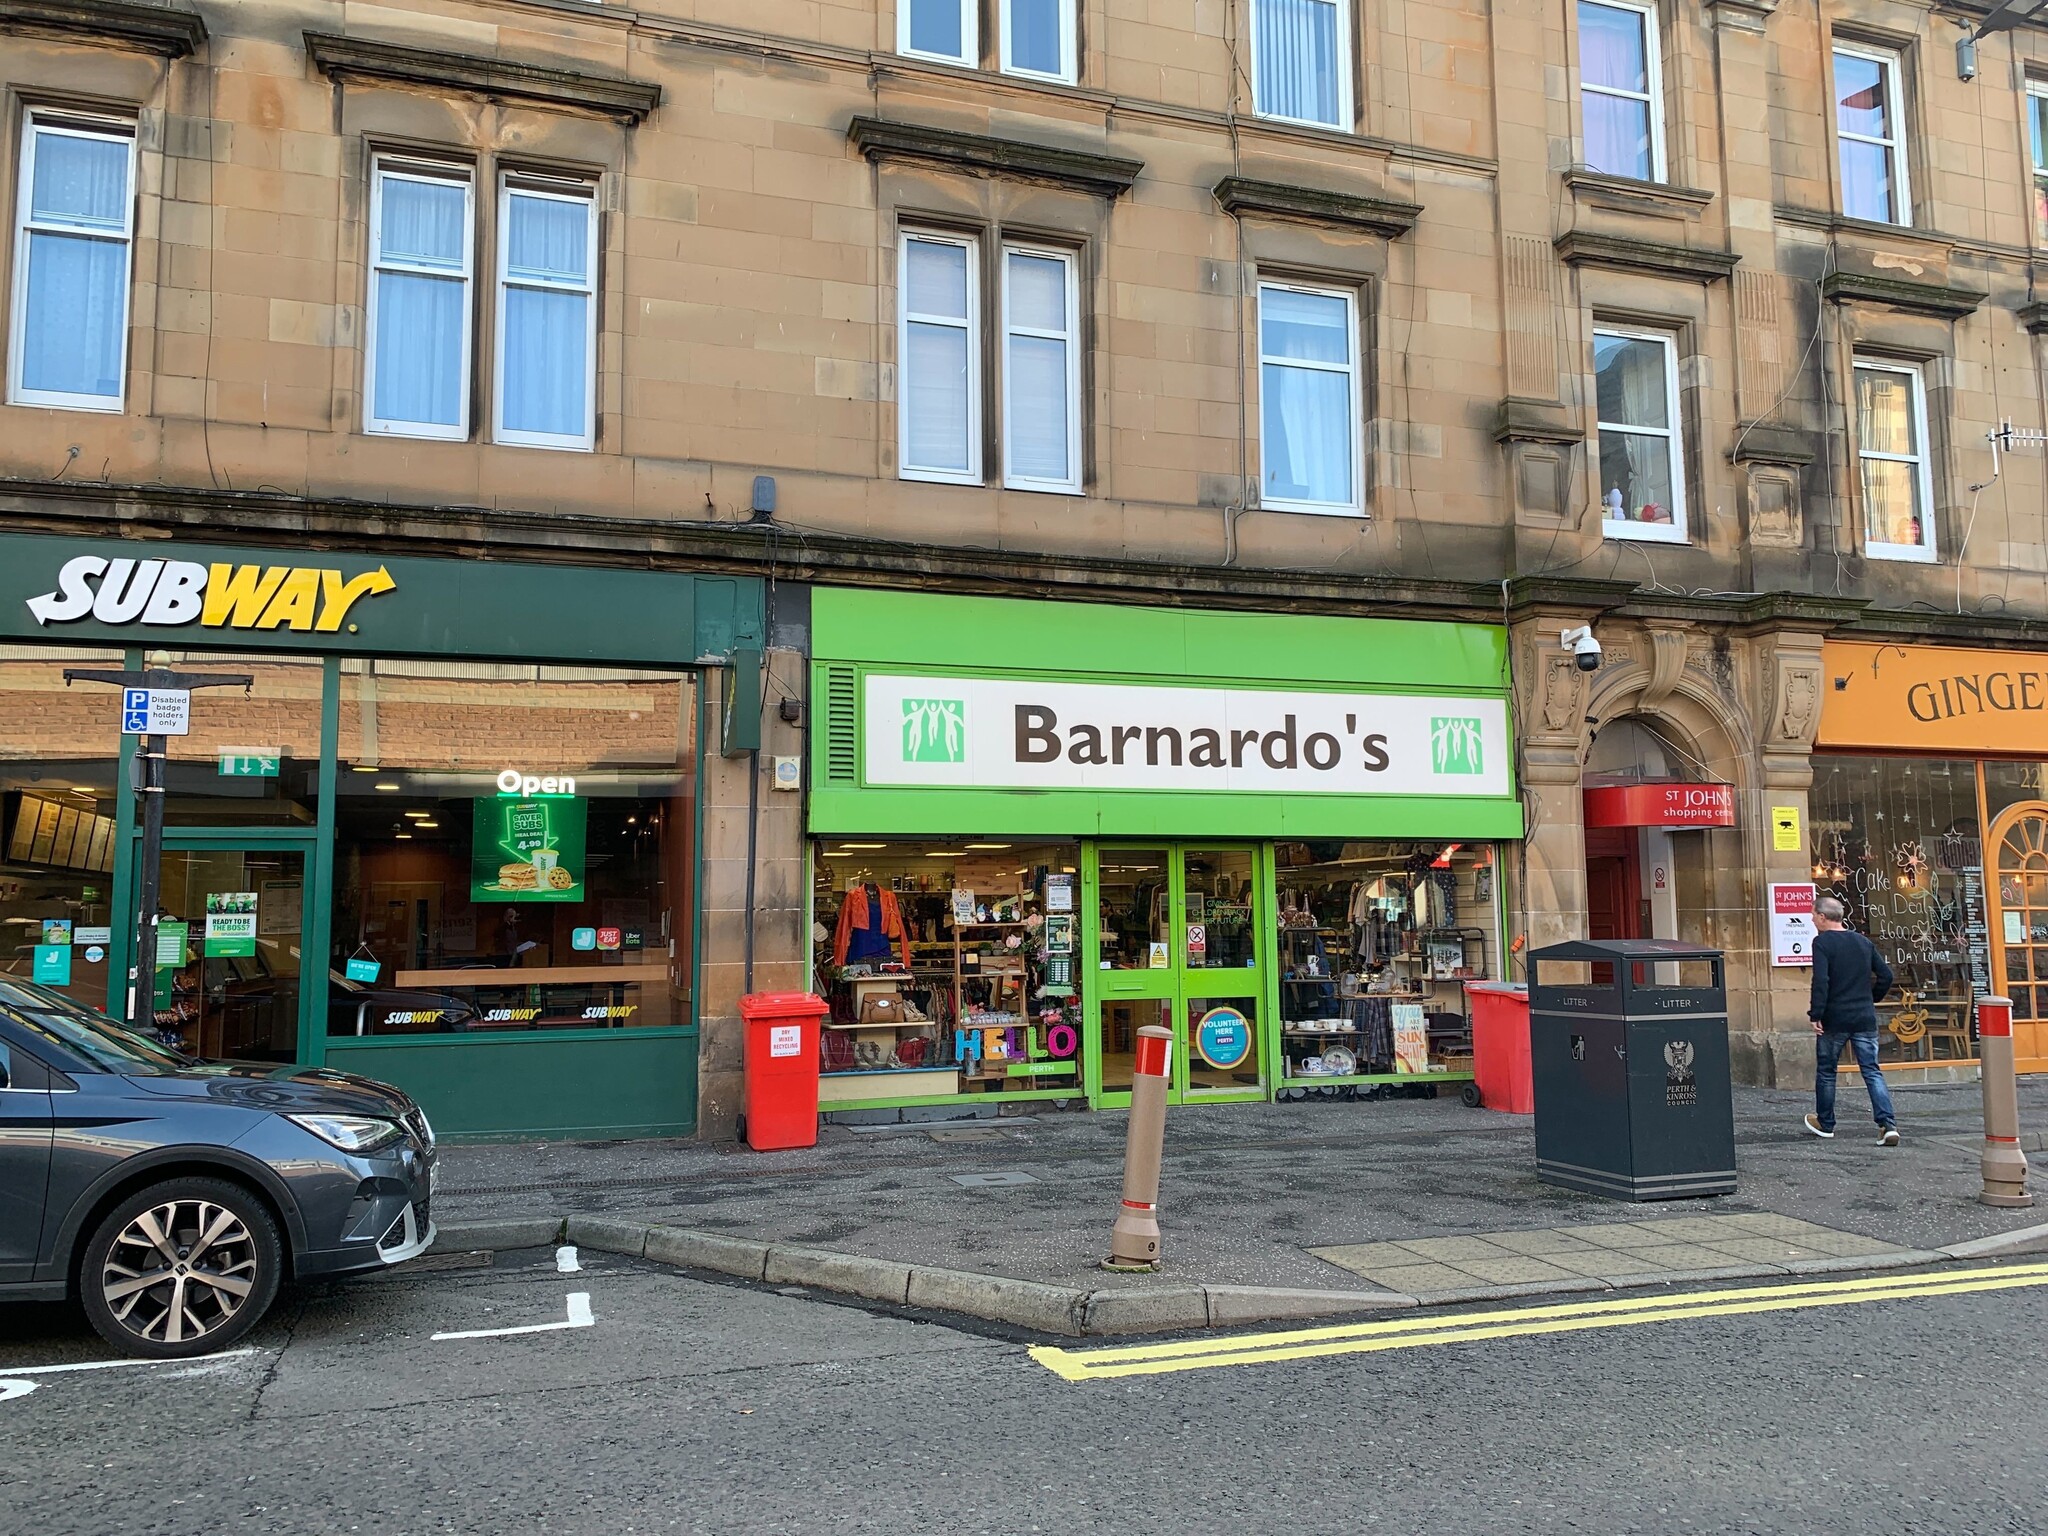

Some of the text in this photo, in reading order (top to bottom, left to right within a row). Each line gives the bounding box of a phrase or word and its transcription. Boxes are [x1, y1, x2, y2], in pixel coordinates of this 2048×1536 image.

[27, 556, 396, 632] SUBWAY
[131, 692, 146, 709] P
[151, 696, 187, 704] Disabled
[1907, 672, 2048, 722] GINGE
[152, 711, 184, 719] holders
[158, 719, 177, 727] only
[1015, 704, 1390, 772] Barnardo's
[497, 769, 575, 798] Open
[1665, 790, 1680, 801] ST
[513, 813, 543, 821] SAVER
[1663, 806, 1713, 819] shopping
[513, 820, 544, 830] SUBS
[517, 840, 541, 850] 4.99
[1855, 867, 1891, 894] Cake
[1783, 891, 1812, 902] JOHN'S
[1893, 893, 1928, 915] Deal
[1793, 944, 1801, 952] JD
[1563, 997, 1588, 1007] LITTER
[1662, 999, 1691, 1008] LITTER
[384, 1010, 444, 1025] SUBWAY
[484, 1008, 542, 1021] SUBWAY
[581, 1005, 638, 1019] SUBWAY
[1202, 1018, 1244, 1029] VOLUNTEER
[1215, 1027, 1234, 1036] HERE
[955, 1024, 1077, 1061] HELLO
[1029, 1064, 1055, 1073] PERTH
[1666, 1085, 1690, 1093] PERTH
[1666, 1092, 1697, 1100] KINROSS
